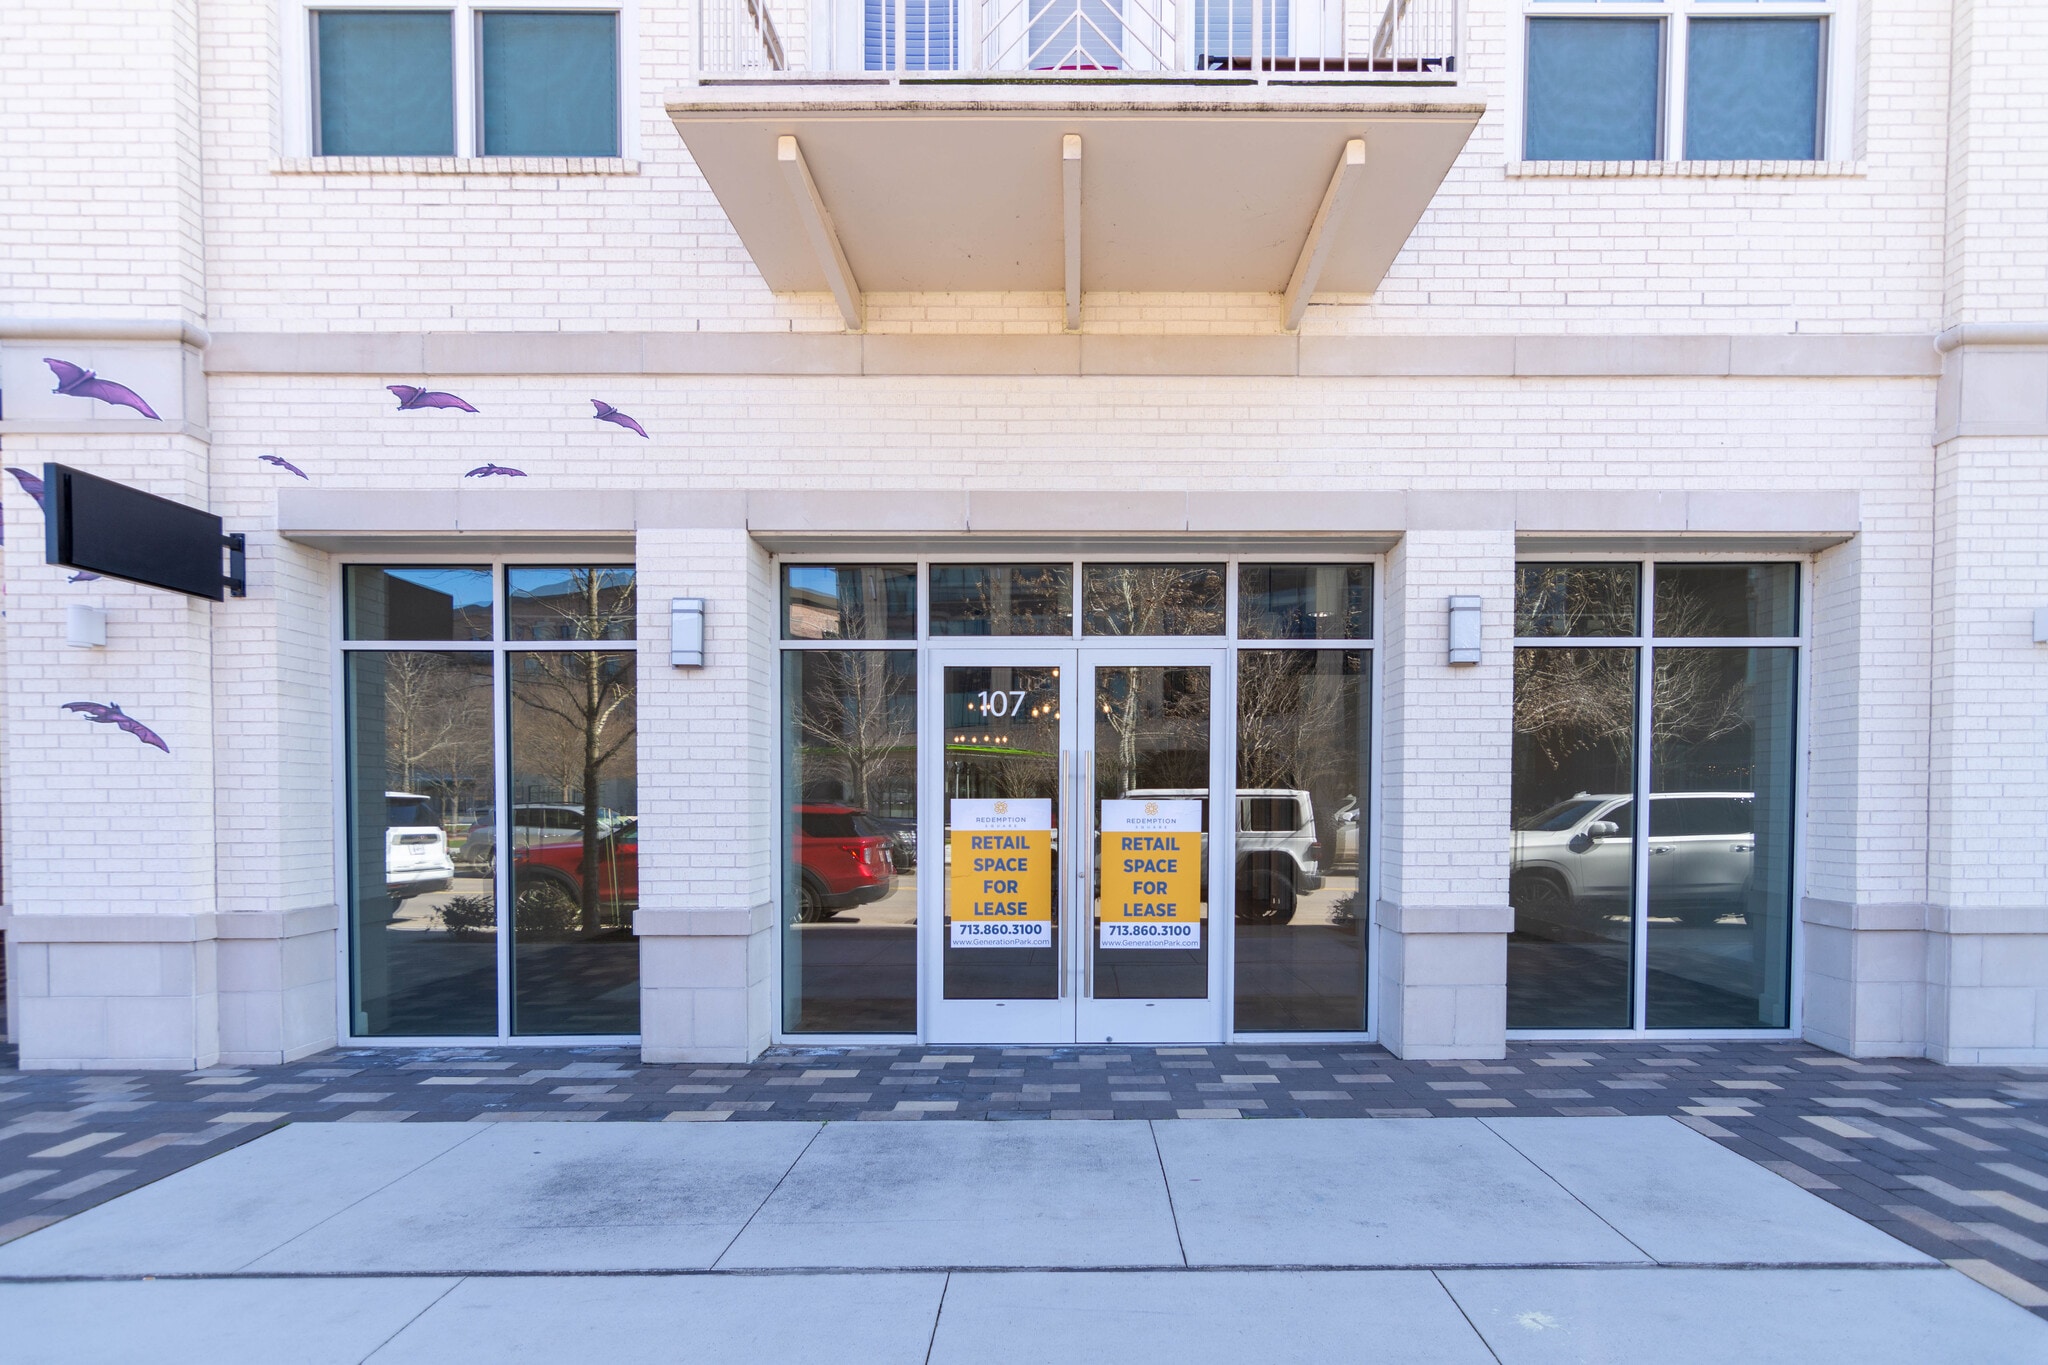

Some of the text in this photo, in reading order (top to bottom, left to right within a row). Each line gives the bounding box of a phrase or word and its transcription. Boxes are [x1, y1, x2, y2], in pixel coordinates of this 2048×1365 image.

[979, 691, 1026, 716] 107
[971, 836, 1030, 850] RETAIL
[1122, 837, 1180, 851] RETAIL
[974, 858, 1028, 872] SPACE
[1123, 859, 1177, 873] SPACE
[984, 880, 1018, 894] FOR
[1133, 881, 1167, 895] FOR
[974, 902, 1027, 916] LEASE
[1123, 903, 1177, 917] LEASE
[960, 925, 1042, 935] 713.860.3100
[1109, 926, 1191, 936] 713.860.3100
[953, 938, 1050, 946] www.GenerationPark.com
[1102, 939, 1199, 947] www.GenerationPark.com
